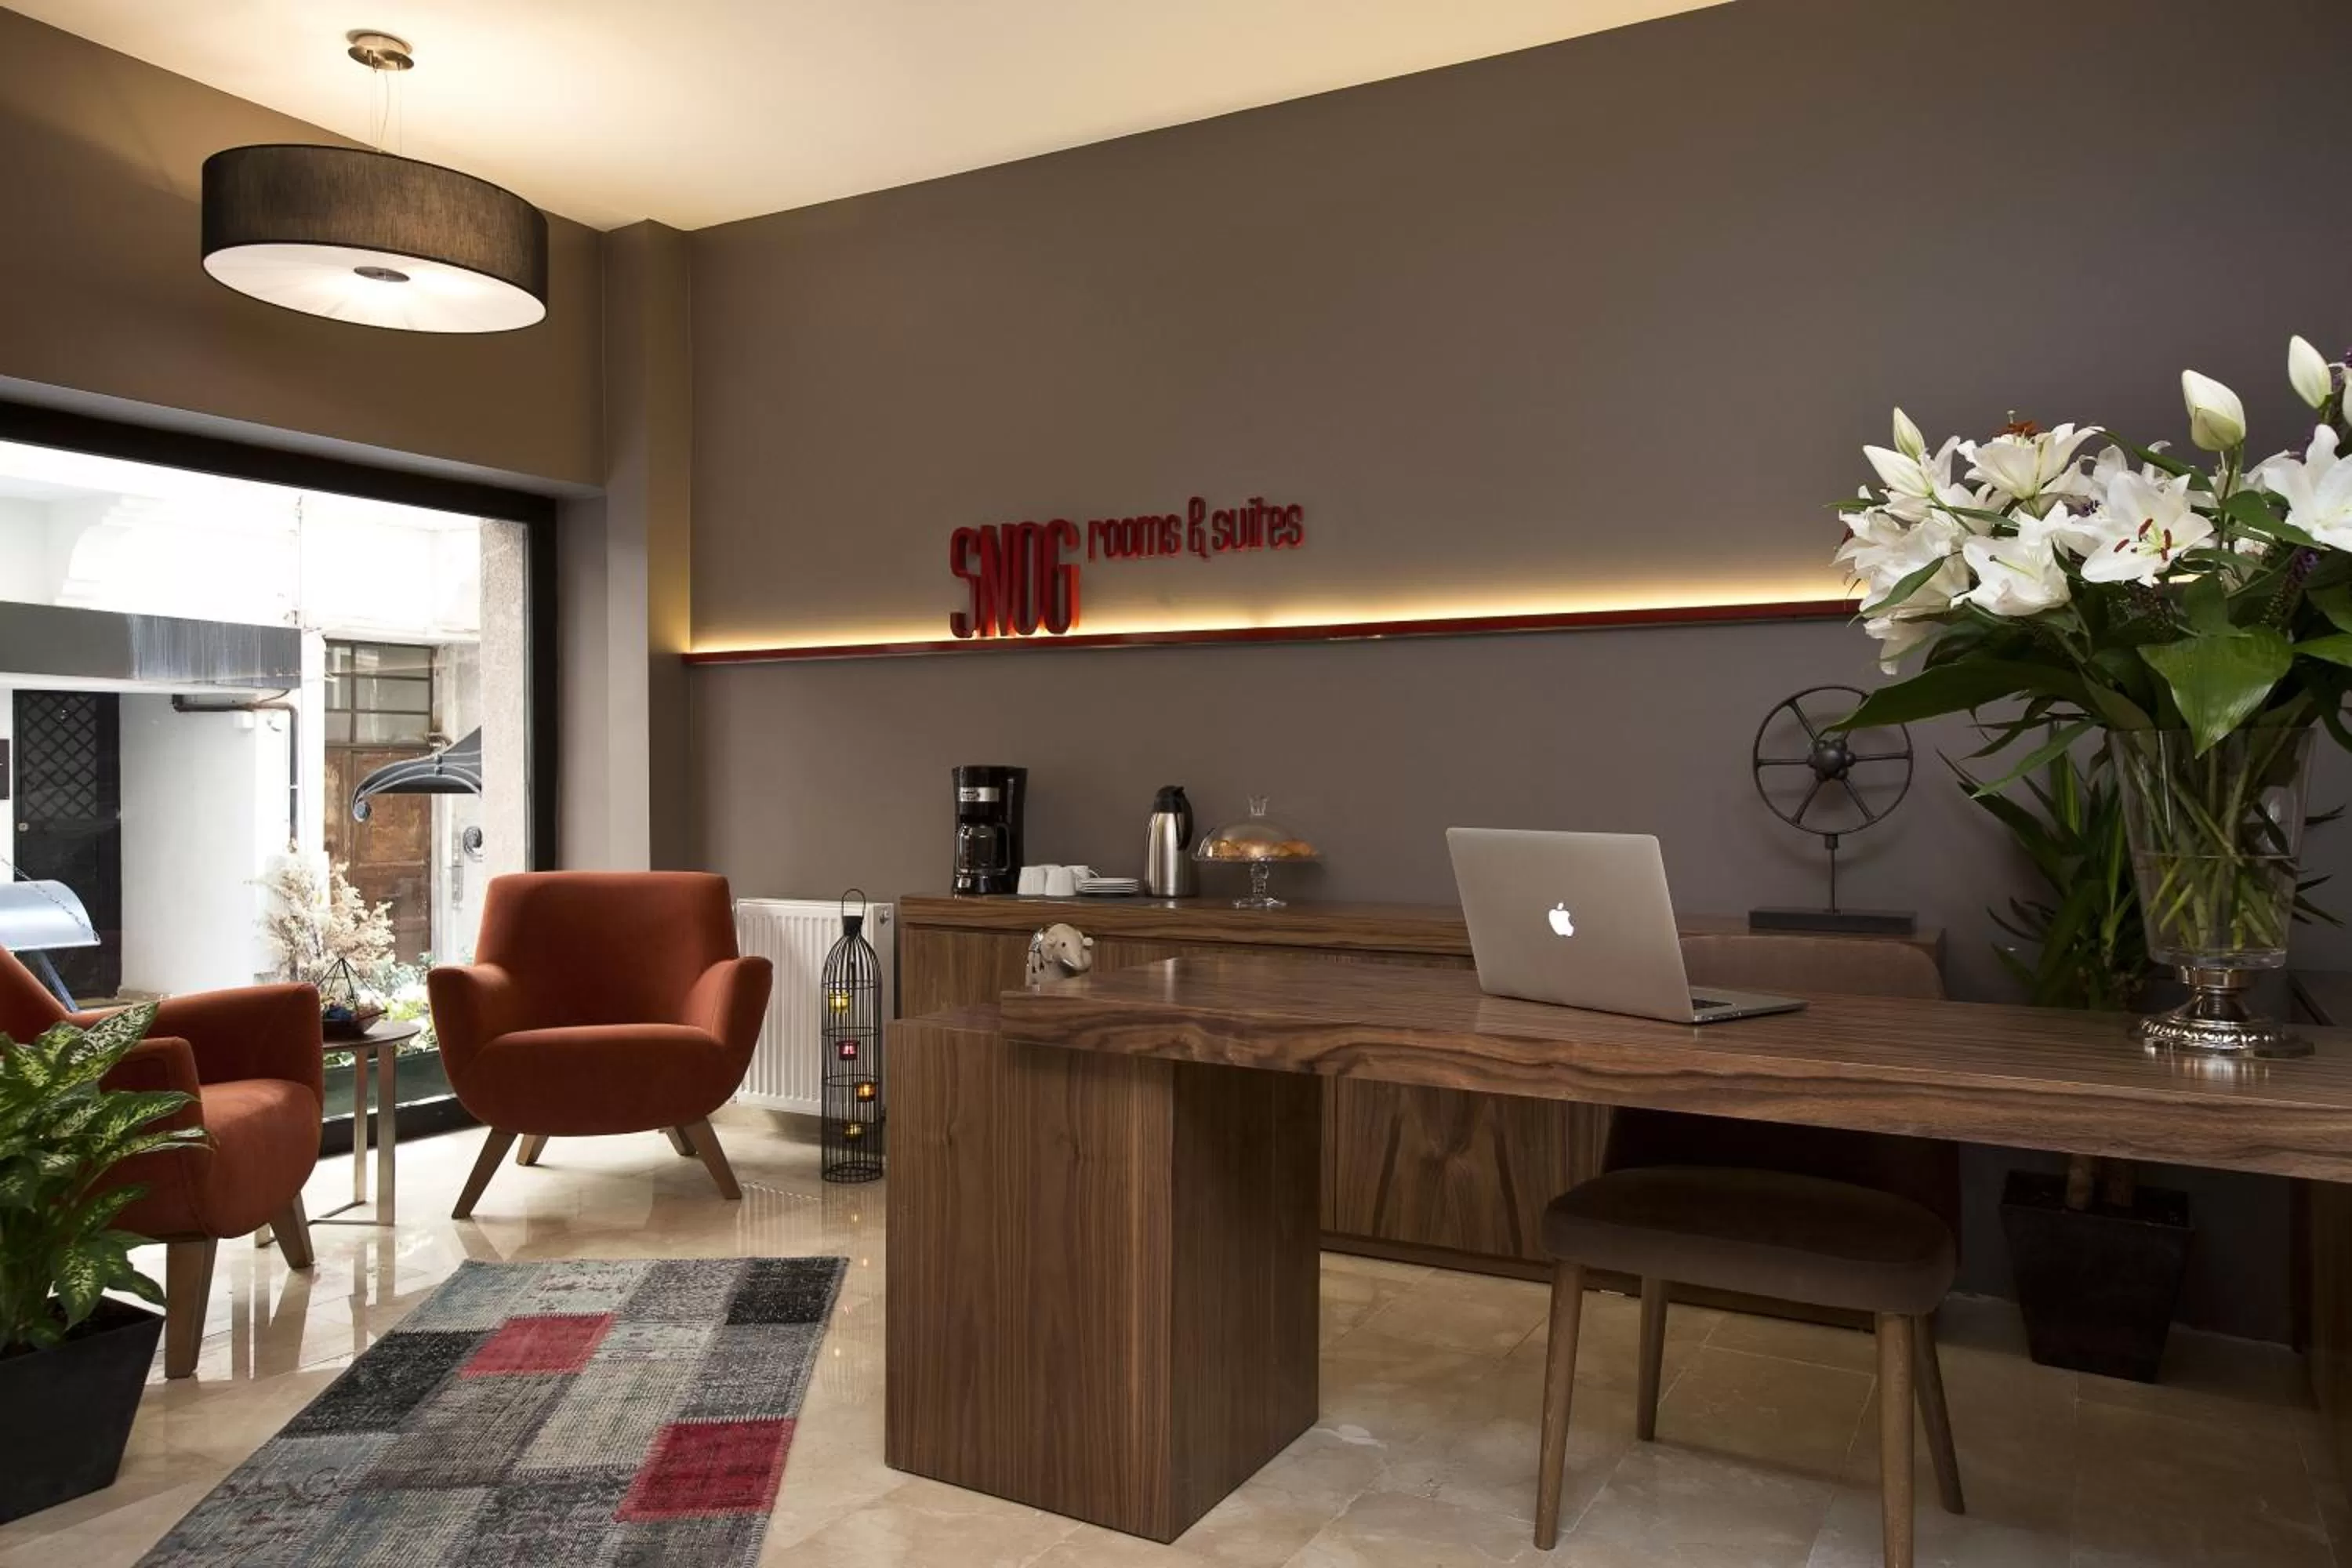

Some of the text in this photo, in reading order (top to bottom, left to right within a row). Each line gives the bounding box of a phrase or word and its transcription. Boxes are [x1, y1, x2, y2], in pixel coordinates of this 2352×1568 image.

[950, 518, 1080, 638] SNOG
[1088, 514, 1182, 563] rooms
[1211, 496, 1305, 551] suites
